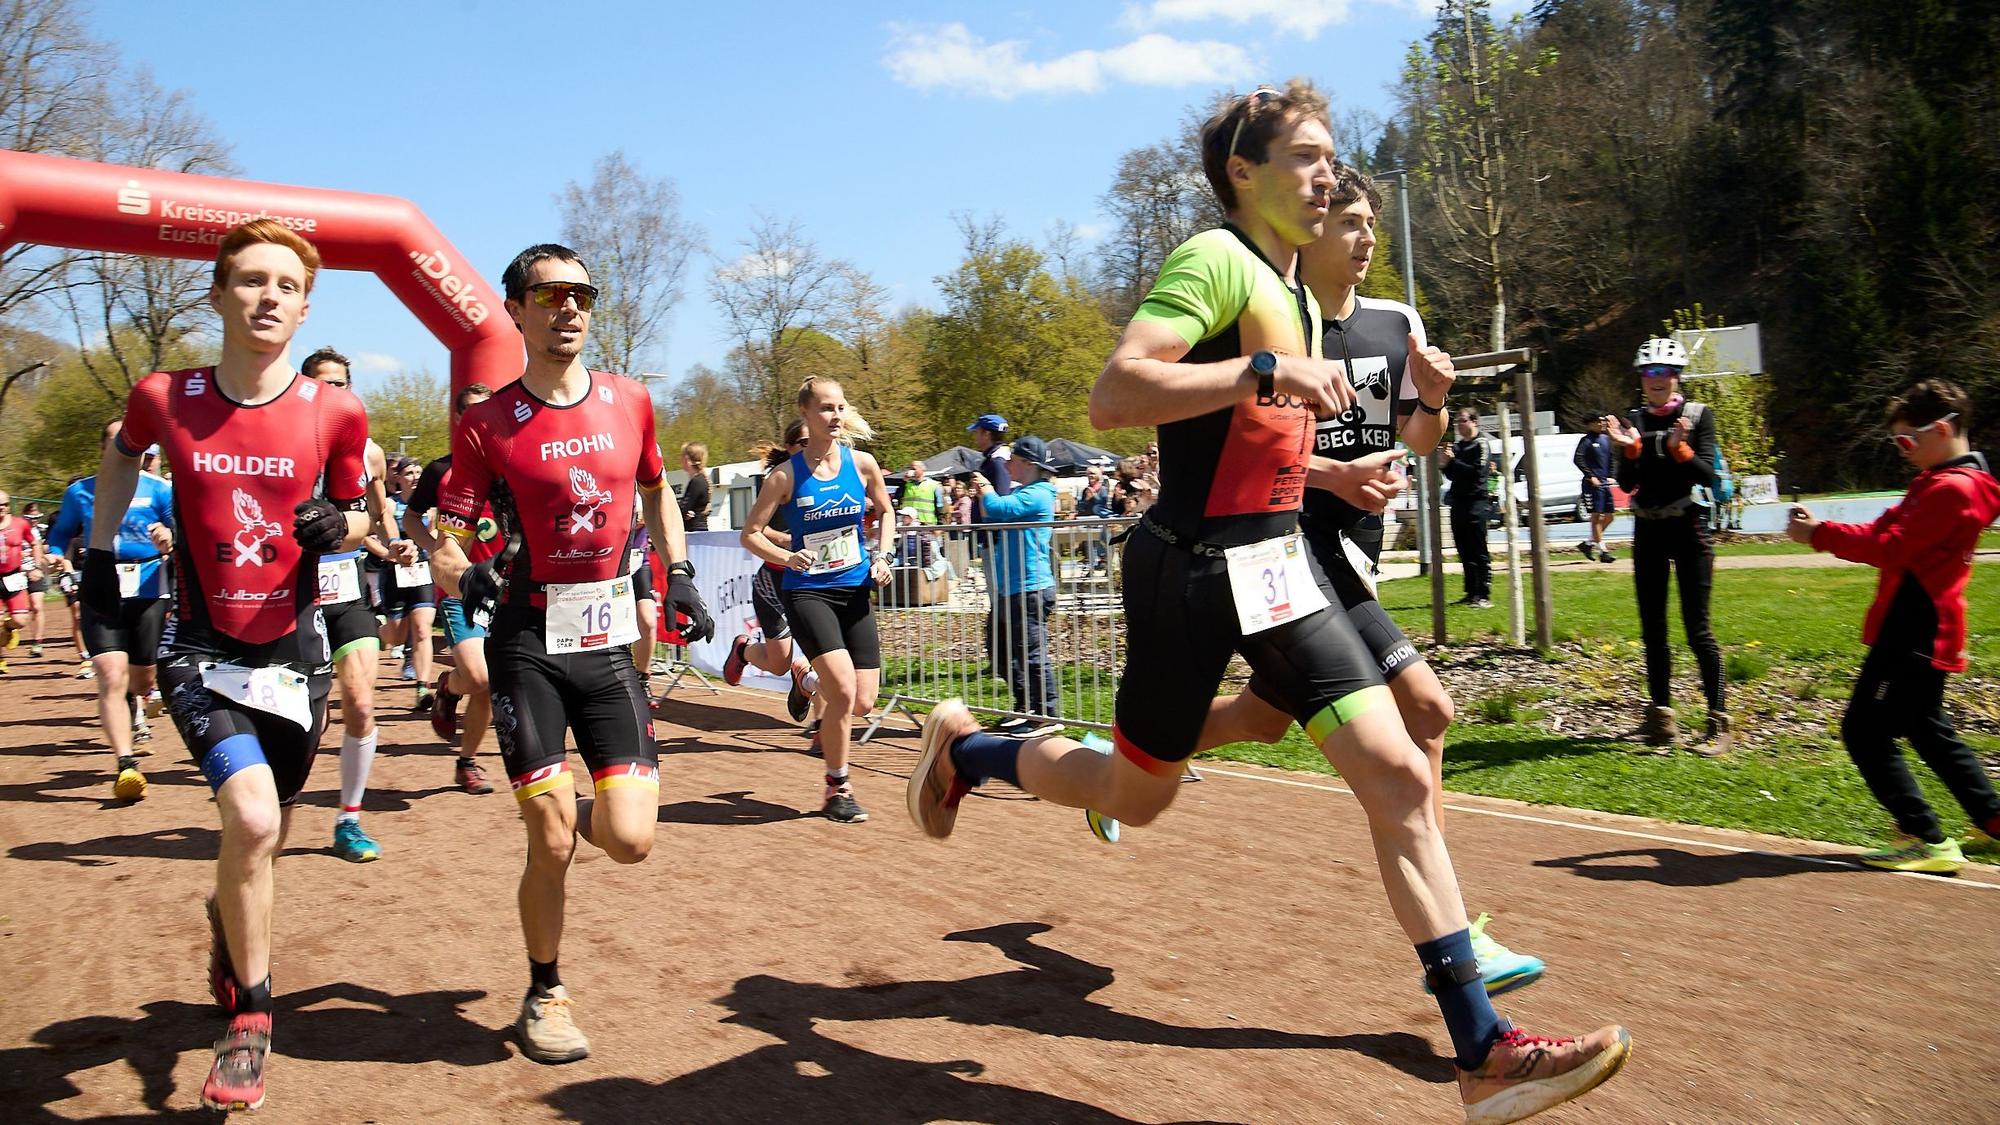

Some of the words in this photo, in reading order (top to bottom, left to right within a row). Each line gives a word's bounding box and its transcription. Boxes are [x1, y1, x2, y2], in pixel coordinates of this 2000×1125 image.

[158, 223, 230, 245] Euskir
[419, 249, 489, 326] Deka
[540, 432, 615, 462] FROHN
[192, 451, 295, 478] HOLDER
[439, 513, 466, 530] EXD
[554, 510, 607, 535] EXD
[803, 504, 862, 522] SKI-KELLER
[215, 541, 277, 568] EXD
[547, 548, 594, 559] Julbo
[820, 540, 850, 563] 210
[211, 588, 268, 601] Julbo
[1262, 562, 1290, 606] 31
[581, 601, 612, 634] 16
[1377, 643, 1416, 675] USION
